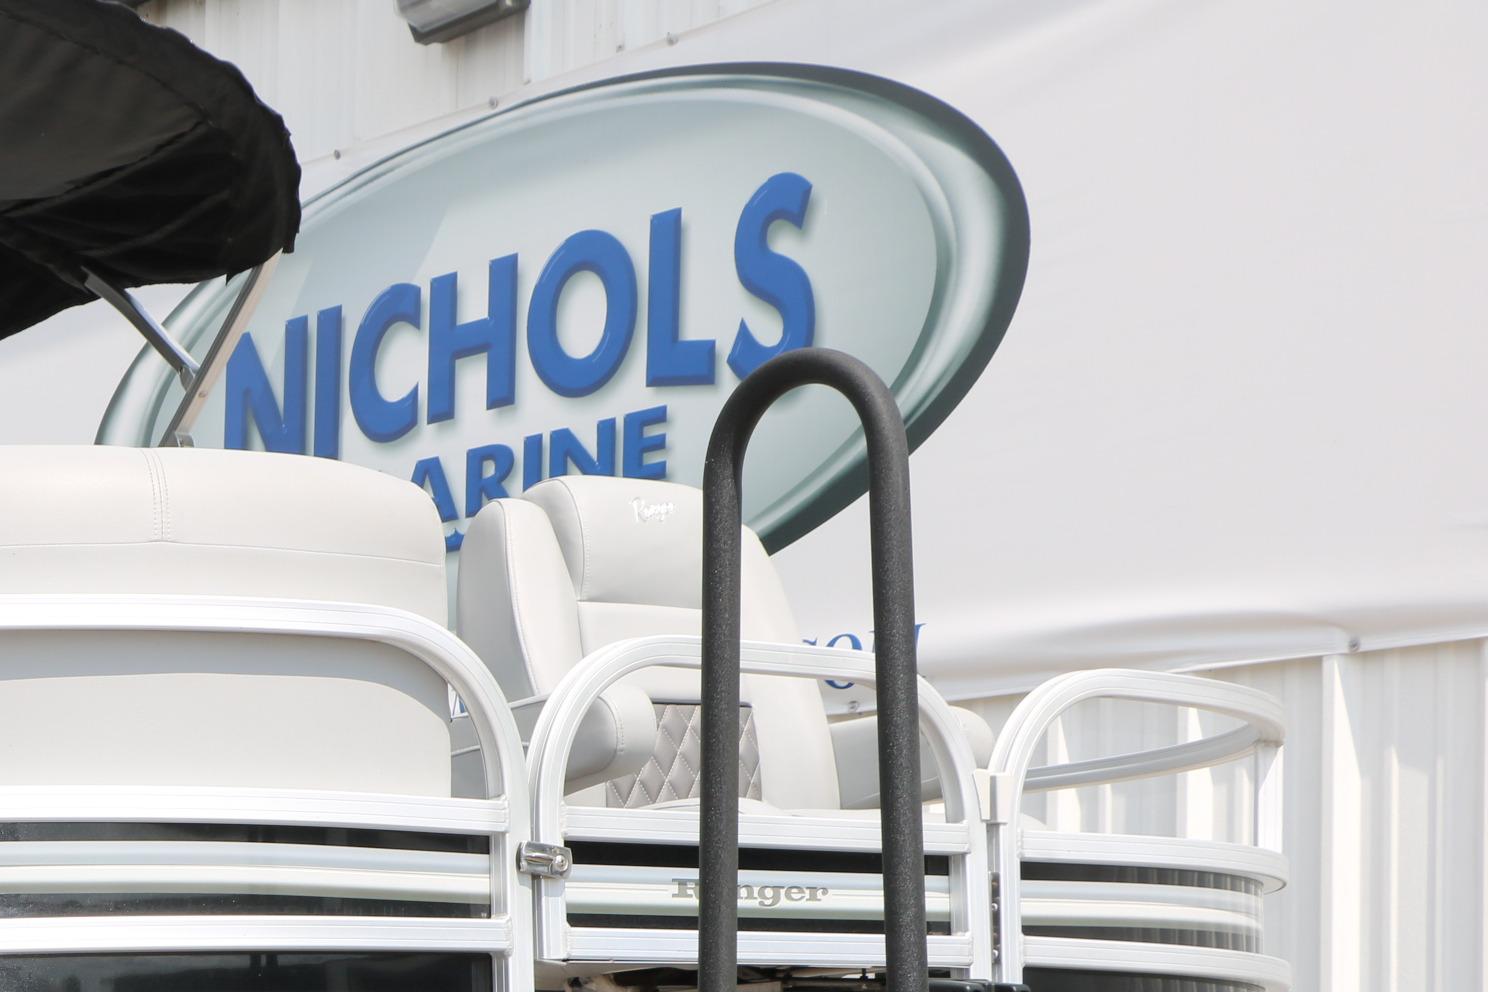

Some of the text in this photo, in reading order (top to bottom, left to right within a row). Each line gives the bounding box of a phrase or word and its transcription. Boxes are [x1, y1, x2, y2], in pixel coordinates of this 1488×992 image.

[224, 171, 816, 461] NICHOLS
[409, 404, 668, 524] ARINE
[671, 878, 830, 908] Rnger
